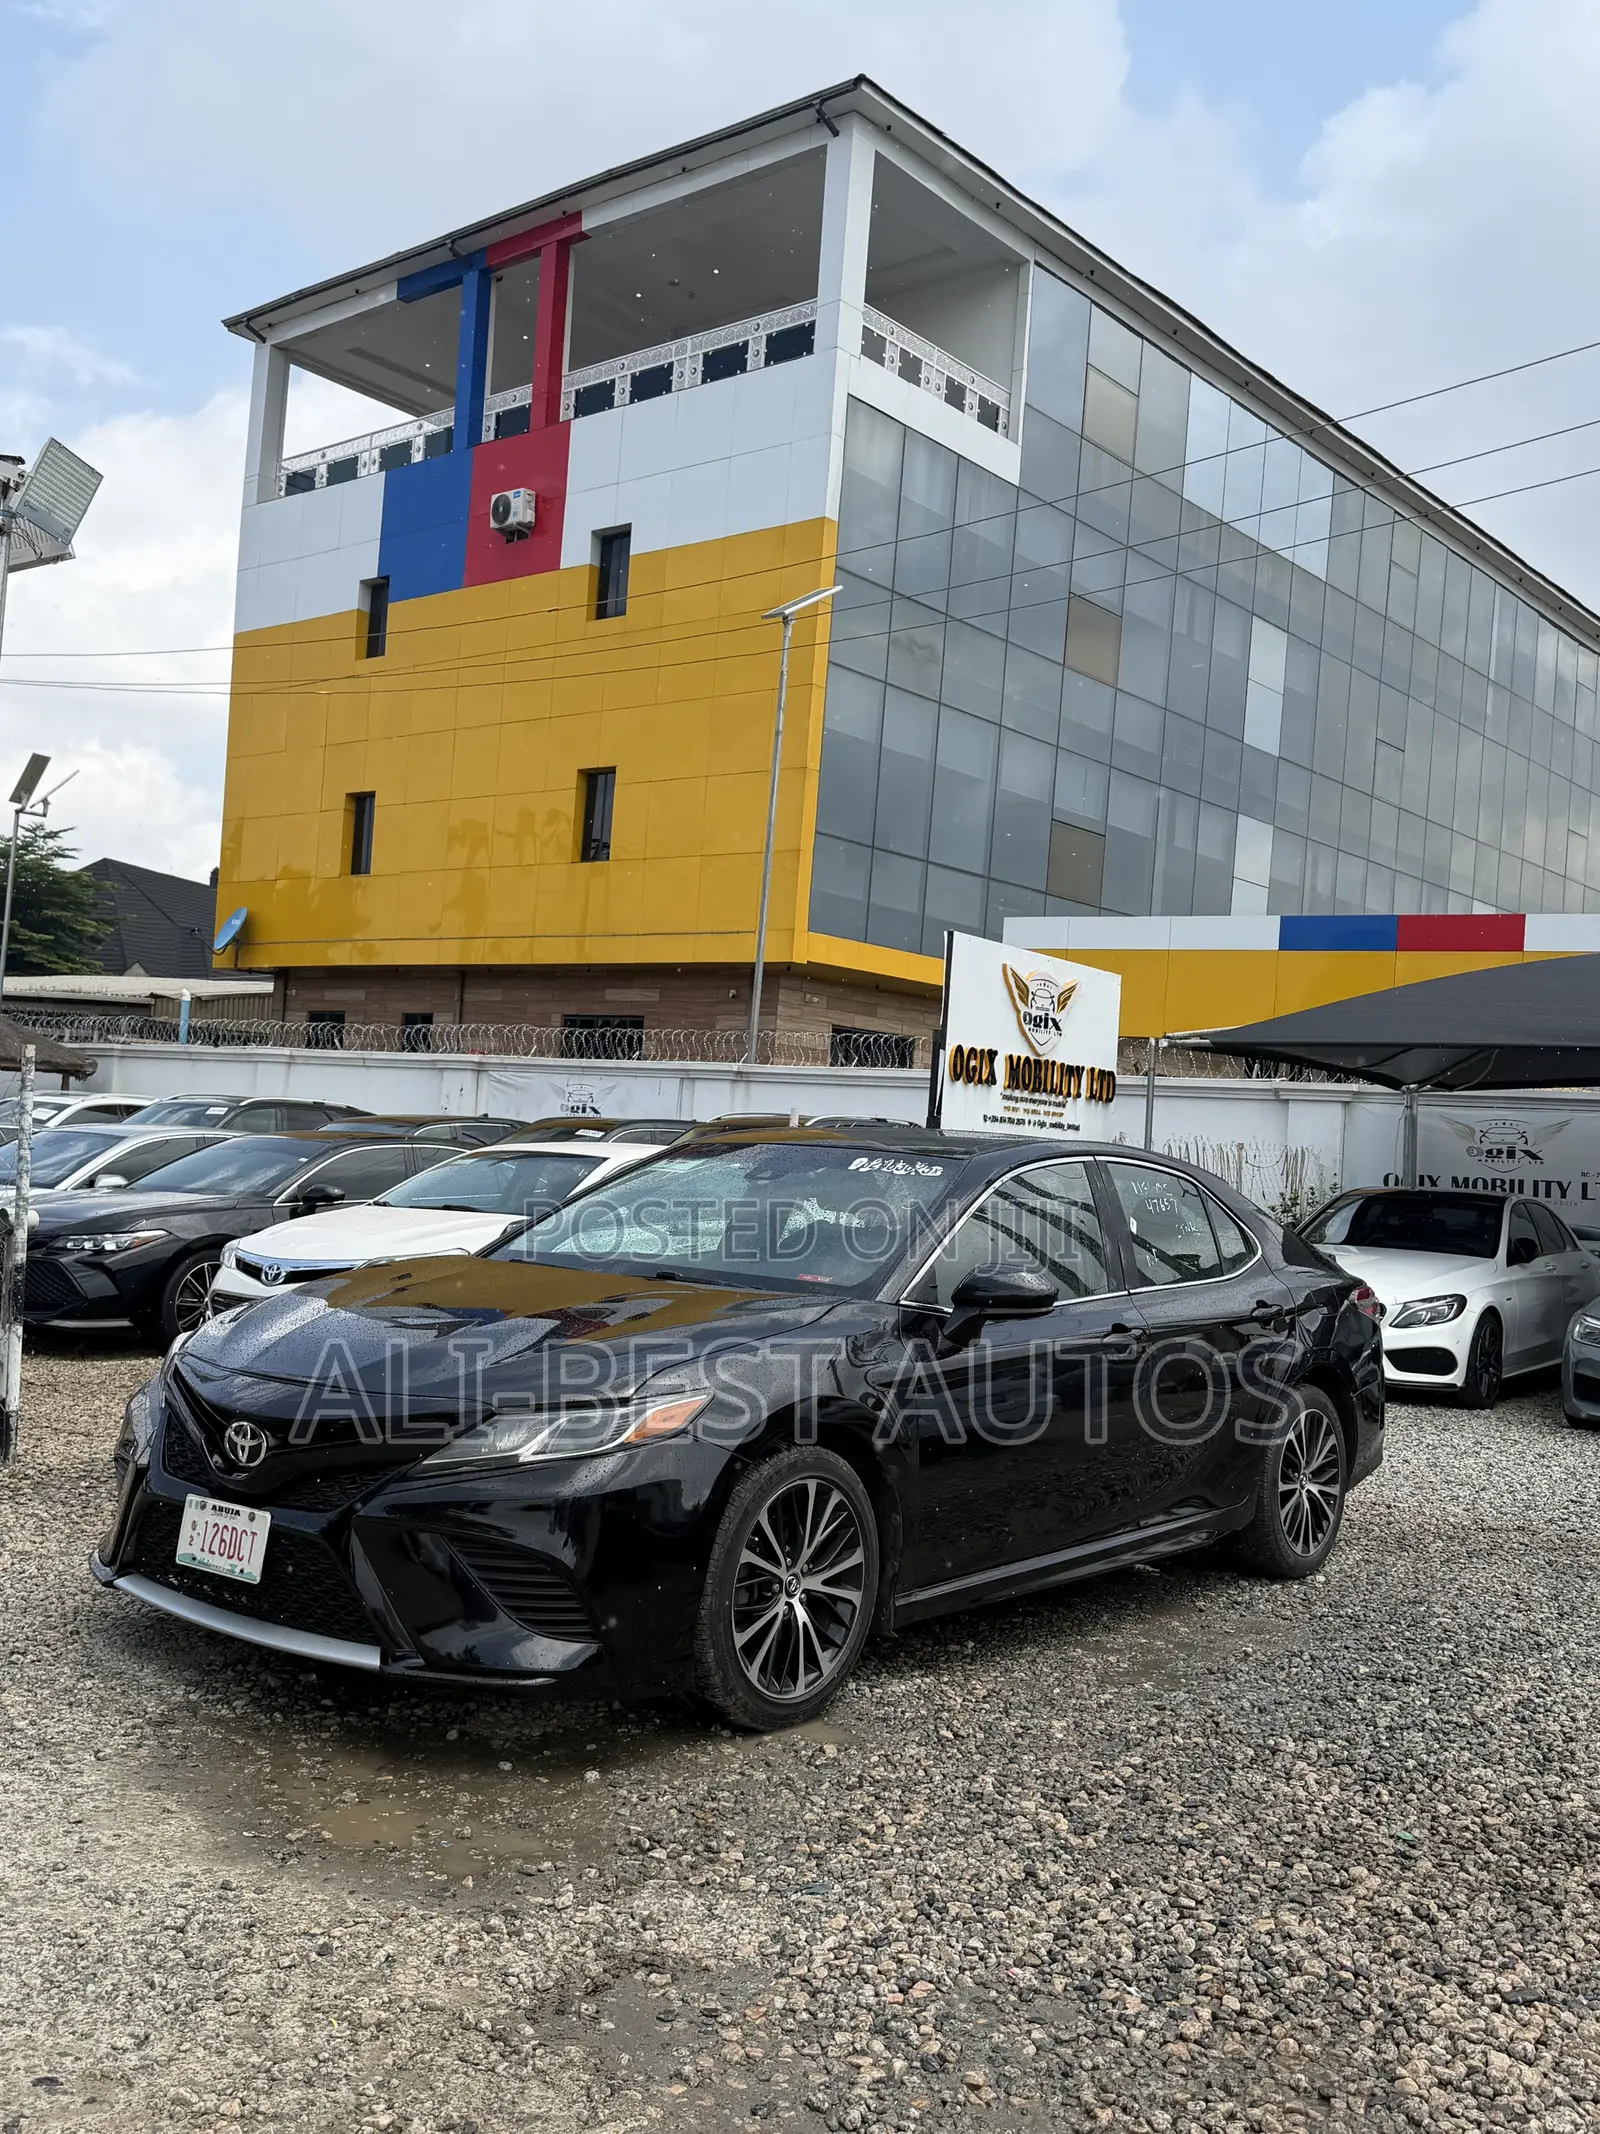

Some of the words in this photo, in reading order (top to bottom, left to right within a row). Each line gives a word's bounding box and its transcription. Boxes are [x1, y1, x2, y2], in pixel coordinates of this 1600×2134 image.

[949, 1044, 998, 1086] OGIX
[1004, 1053, 1085, 1099] MOBILITY
[1085, 1066, 1116, 1103] LTD
[1383, 1172, 1441, 1188] OIX
[1451, 1175, 1572, 1199] MOBILITY
[211, 1504, 241, 1517] ABUJA
[200, 1520, 258, 1566] 126DCT
